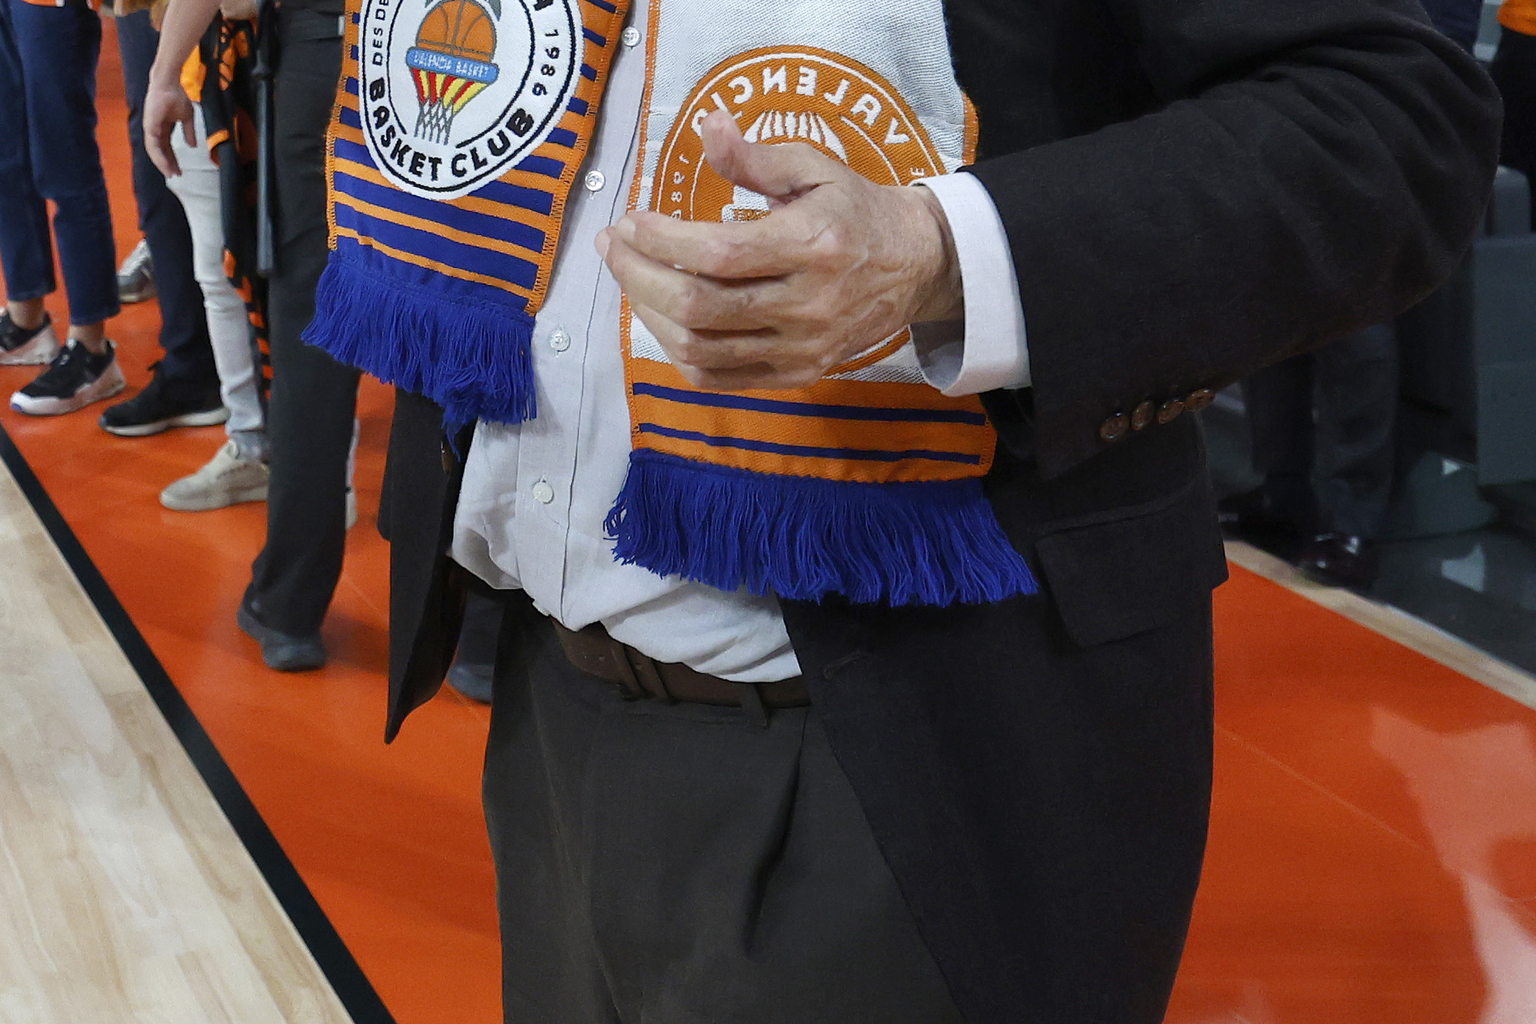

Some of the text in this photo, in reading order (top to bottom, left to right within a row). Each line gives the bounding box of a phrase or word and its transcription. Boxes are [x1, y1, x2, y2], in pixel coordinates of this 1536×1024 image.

[531, 28, 560, 97] 1986
[369, 77, 535, 181] BASKET CLUB
